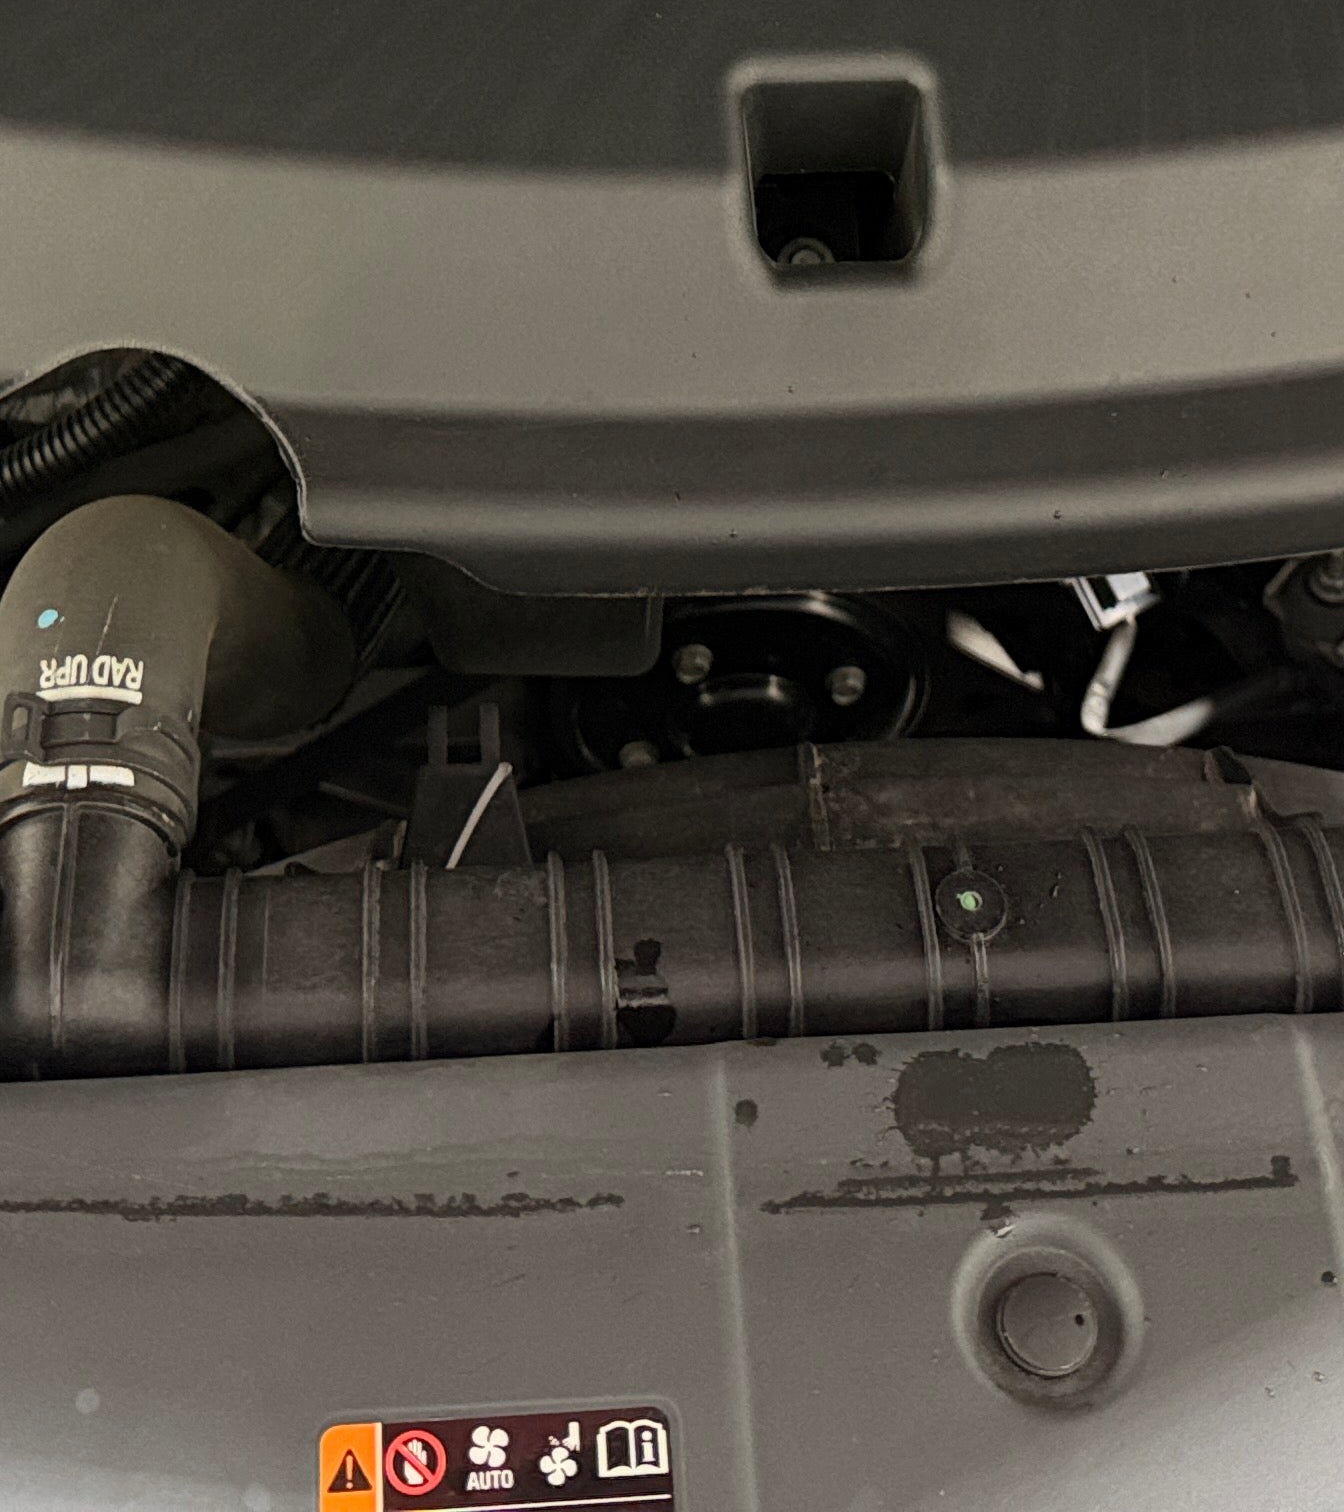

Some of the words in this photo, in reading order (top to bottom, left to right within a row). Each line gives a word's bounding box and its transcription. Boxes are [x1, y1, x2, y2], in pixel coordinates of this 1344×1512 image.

[39, 654, 89, 690] UPR
[92, 654, 144, 691] RAD
[465, 1469, 515, 1491] AUTO
